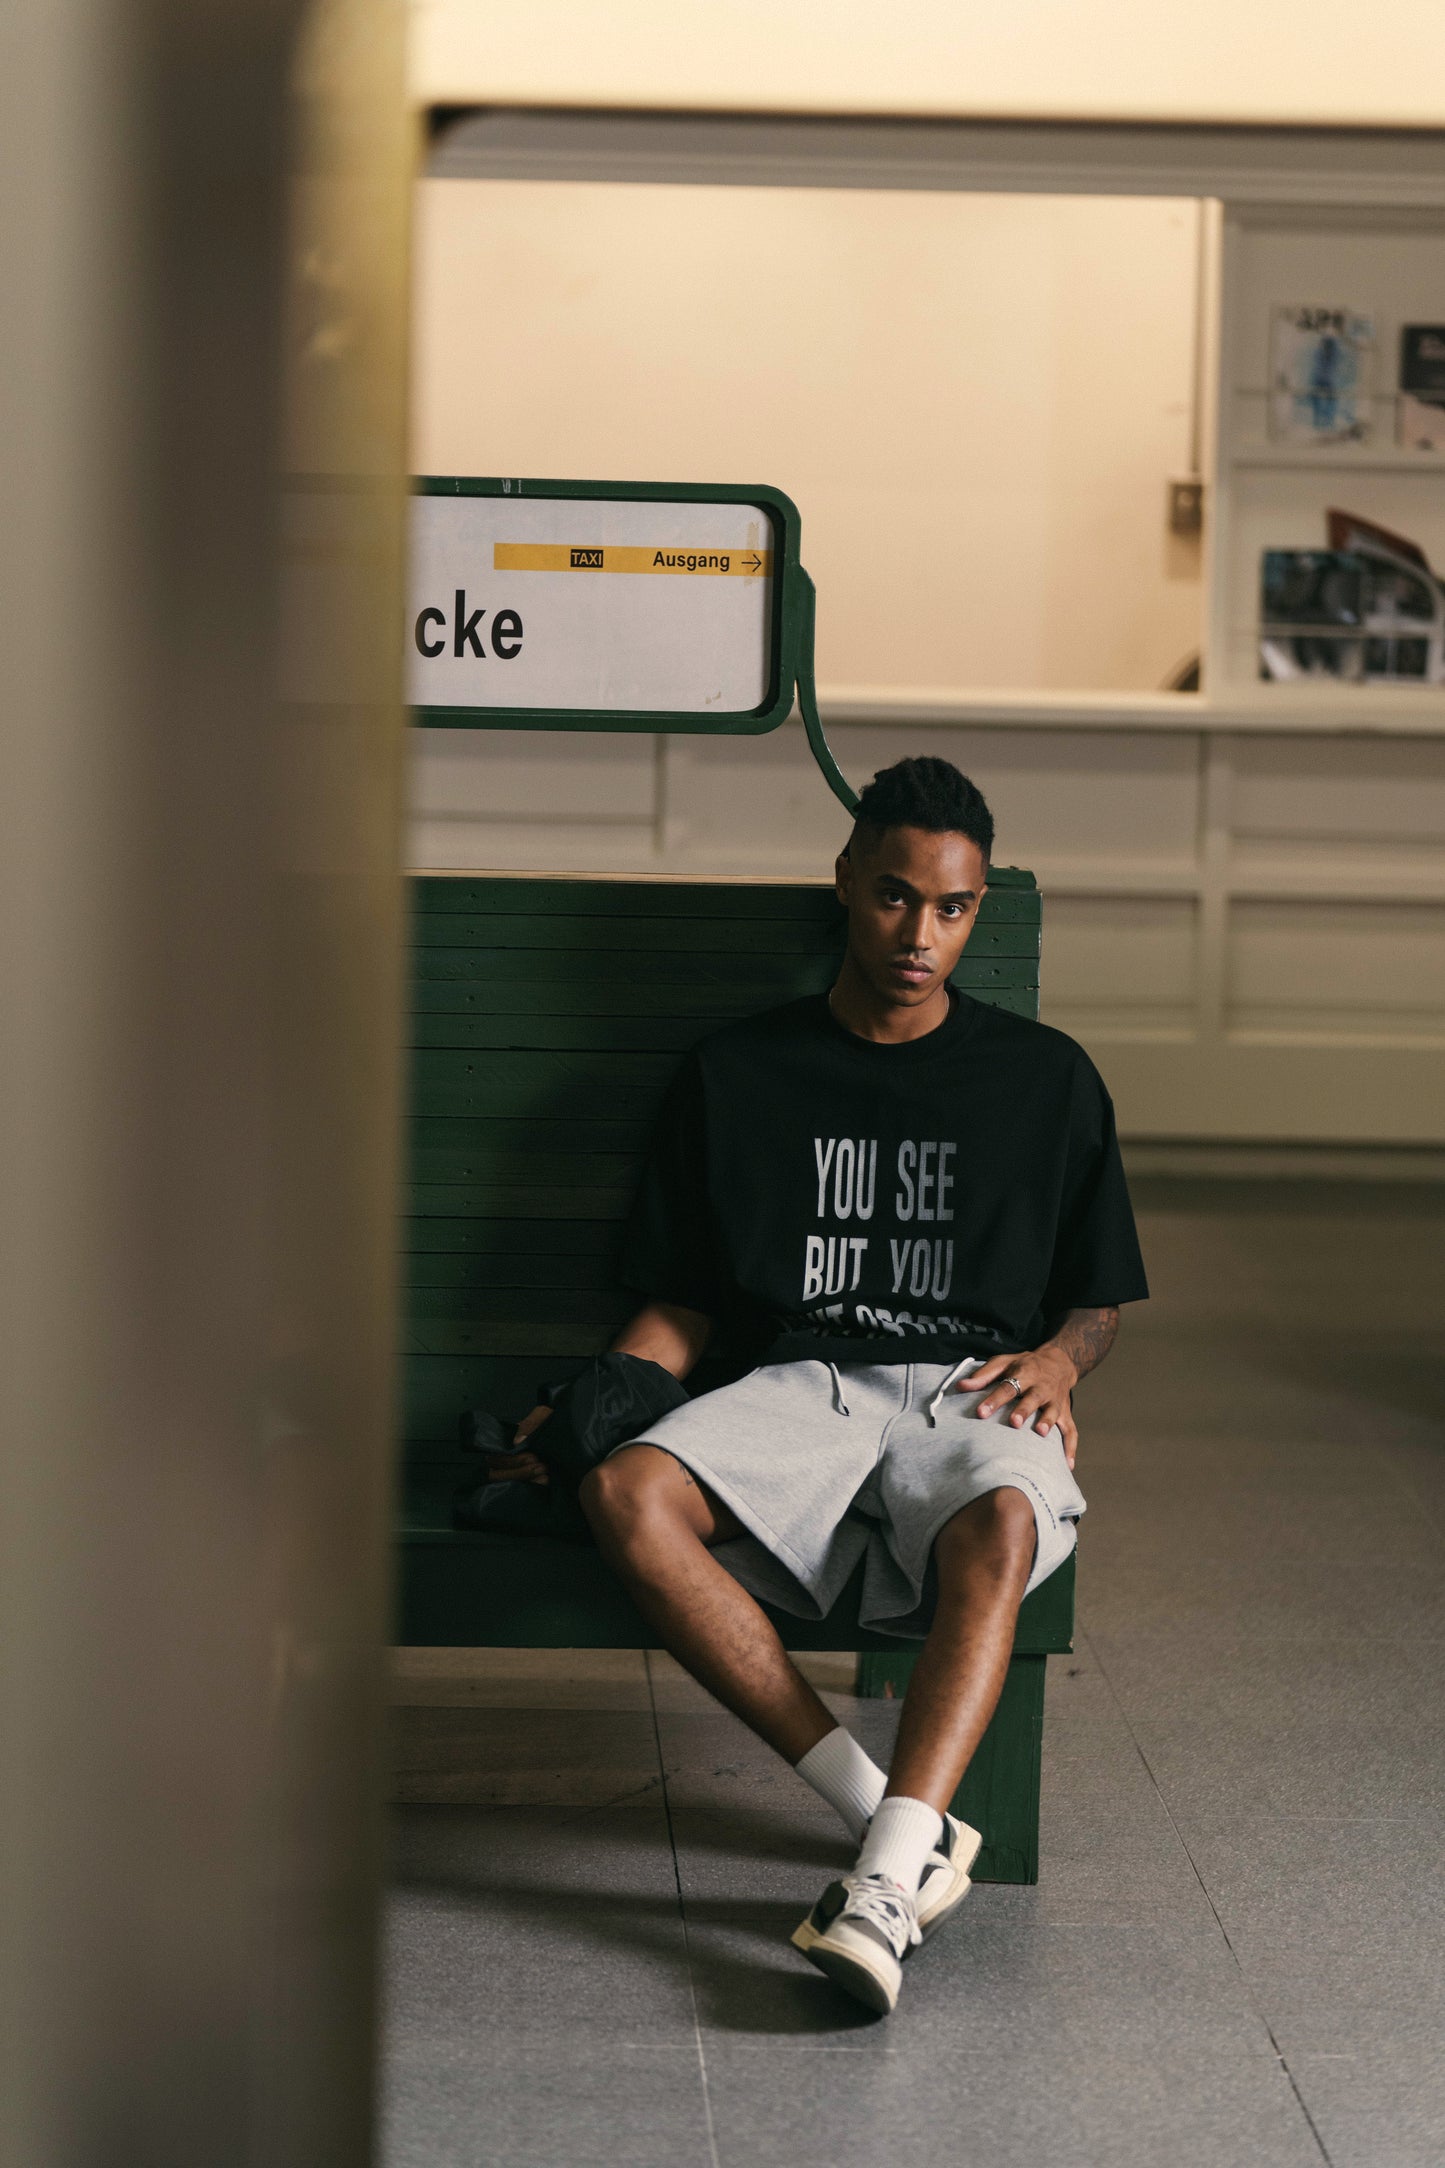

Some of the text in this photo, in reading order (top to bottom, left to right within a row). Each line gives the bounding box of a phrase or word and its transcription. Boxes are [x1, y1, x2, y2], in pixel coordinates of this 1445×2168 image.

[571, 551, 730, 572] TAXI Ausgang
[415, 589, 524, 659] cke
[814, 1137, 957, 1221] YOU SEE
[802, 1235, 954, 1301] BUT YOU
